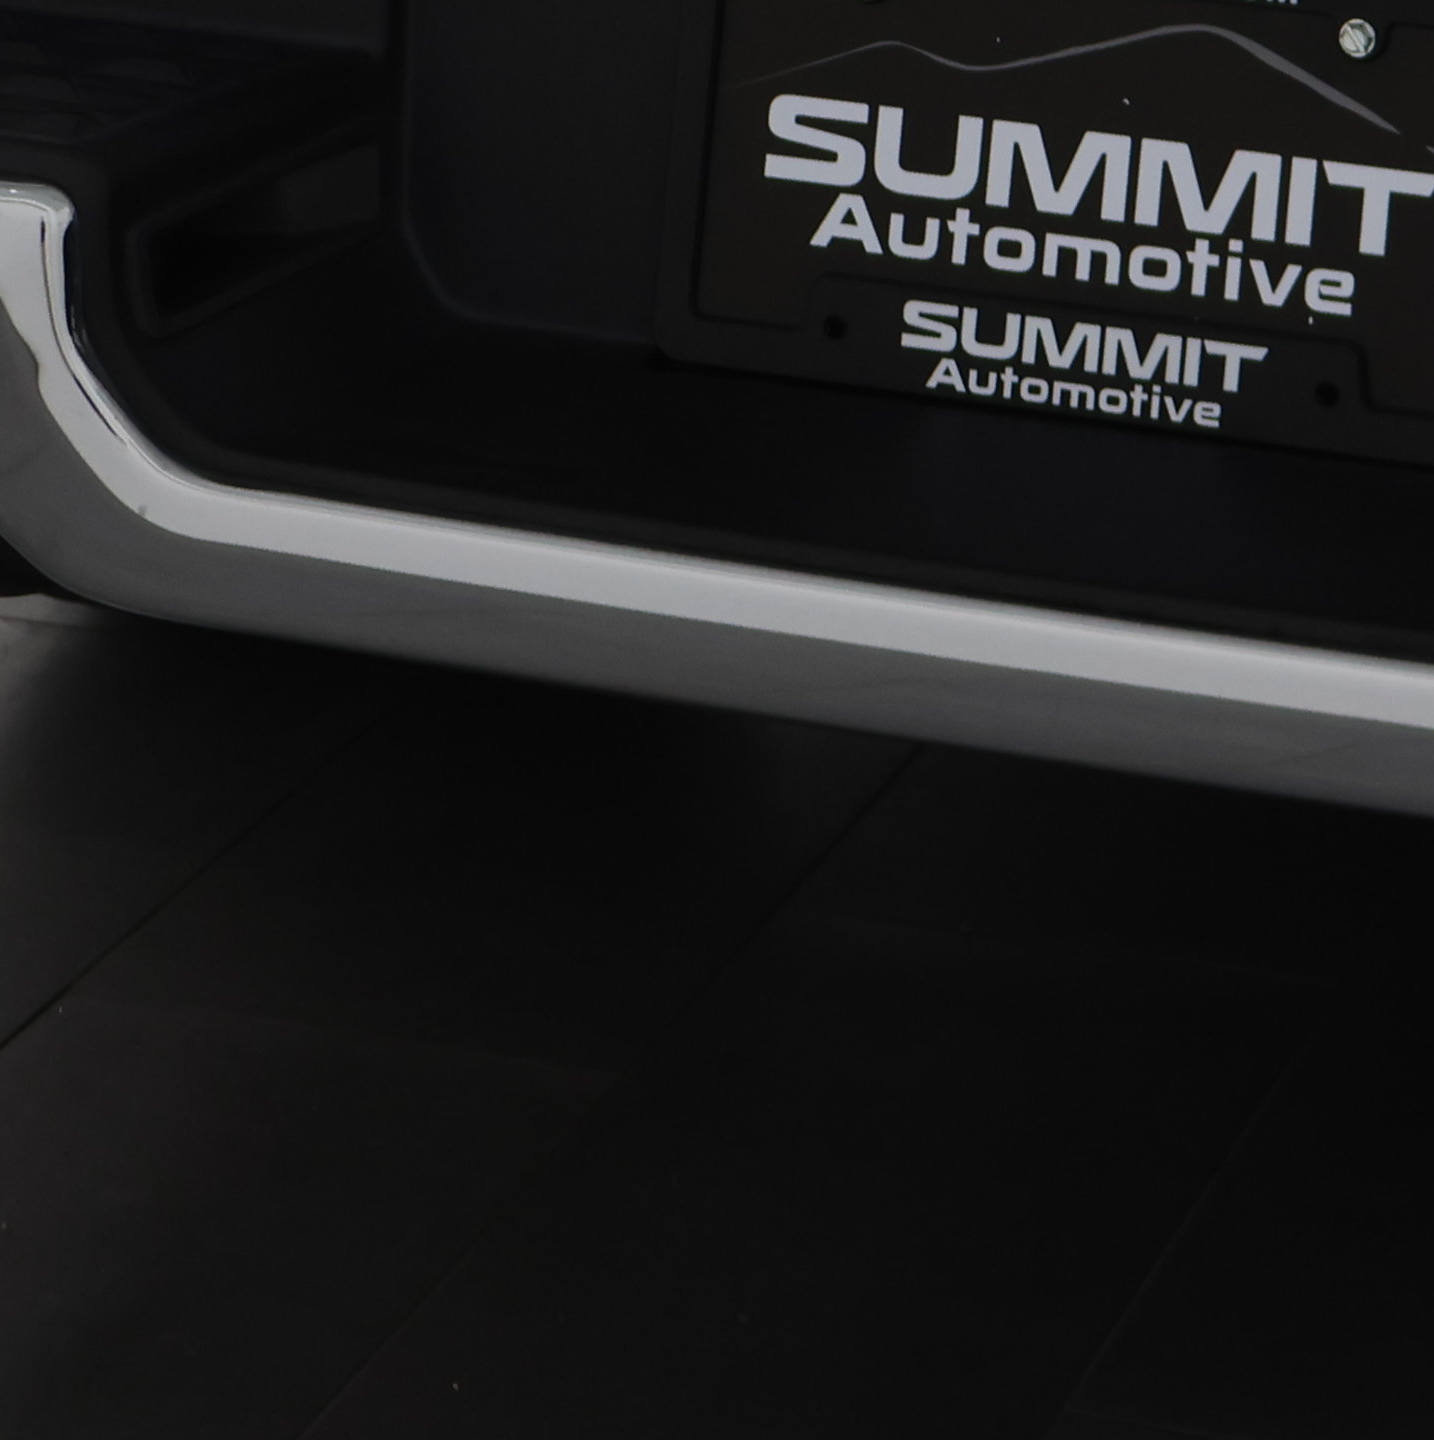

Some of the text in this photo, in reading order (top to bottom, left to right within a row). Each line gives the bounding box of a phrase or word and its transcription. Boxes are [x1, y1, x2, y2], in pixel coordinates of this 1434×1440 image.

[809, 193, 1356, 317] Automotive
[900, 299, 1269, 394] SUMMIT
[925, 357, 1223, 430] Automotive
